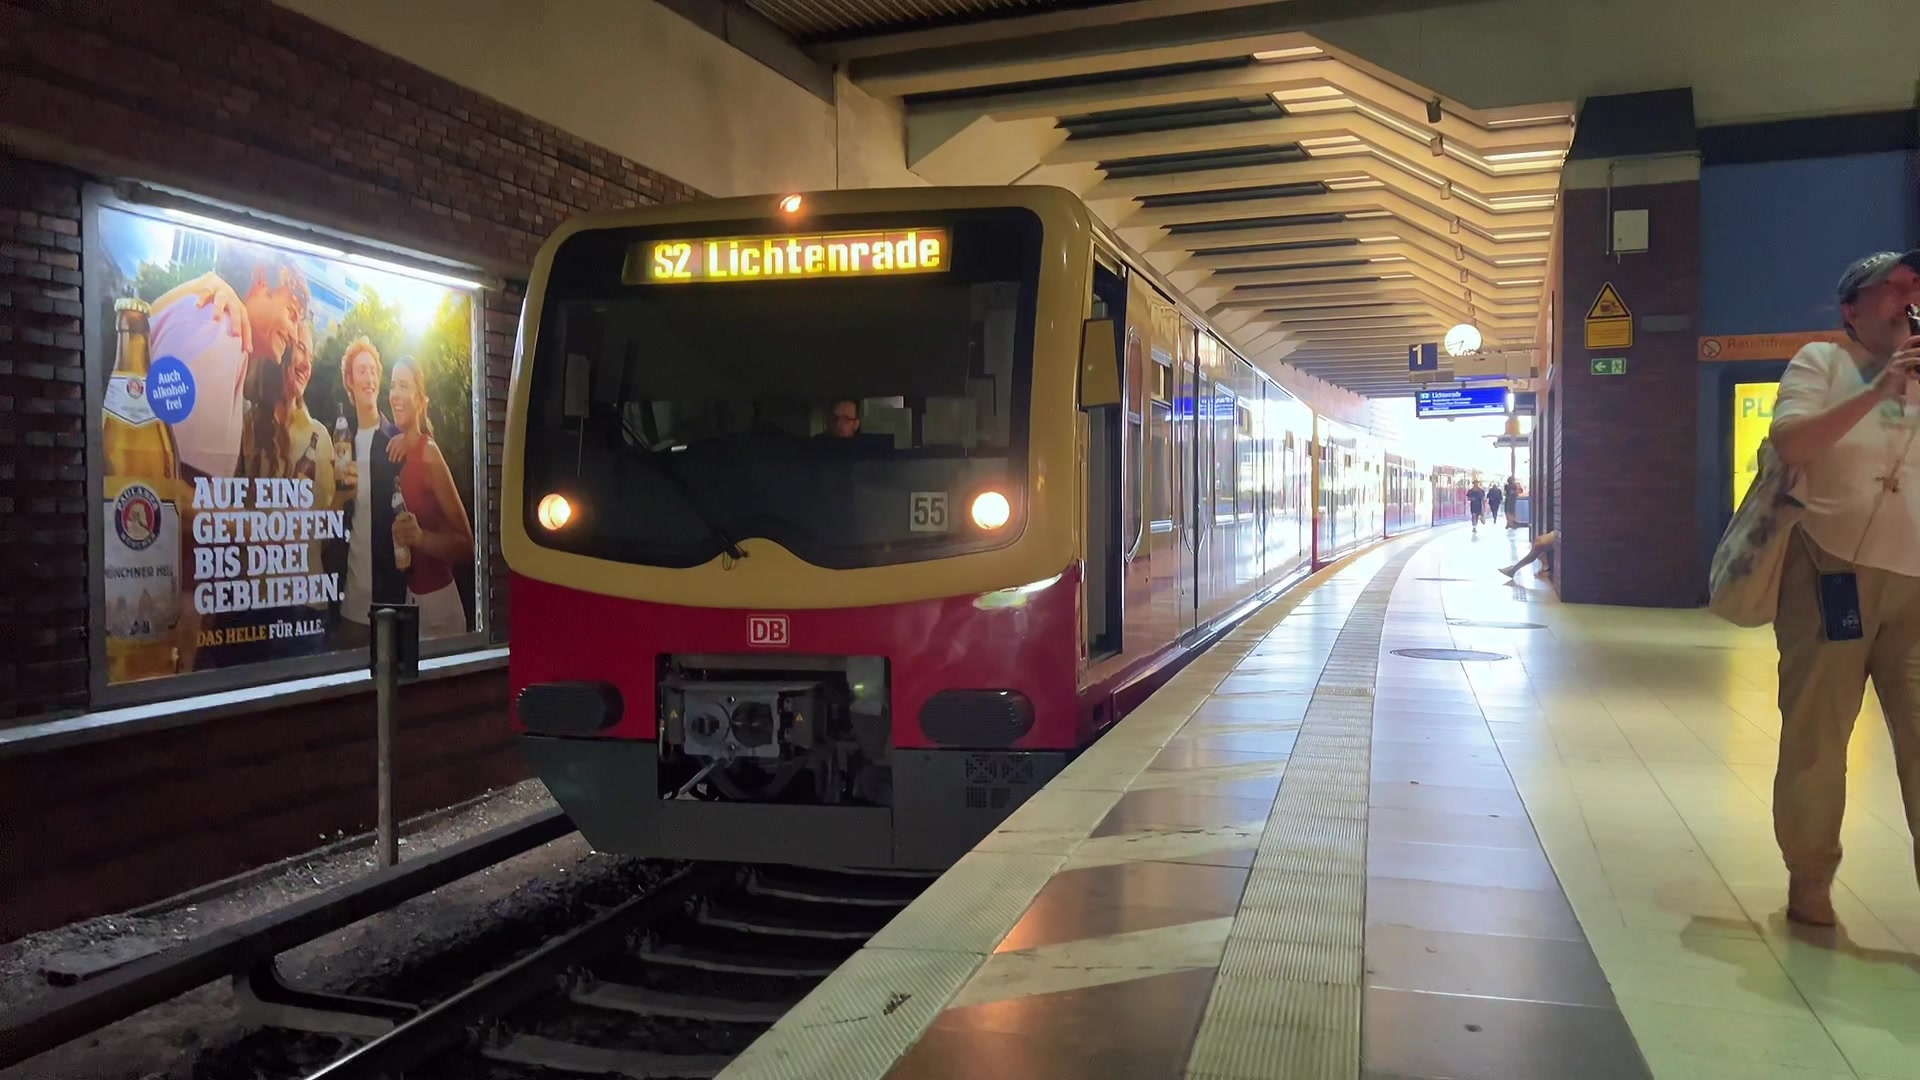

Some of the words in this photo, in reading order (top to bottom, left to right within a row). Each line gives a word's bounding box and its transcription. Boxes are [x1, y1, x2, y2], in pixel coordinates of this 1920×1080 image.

[654, 241, 692, 280] S2
[707, 230, 942, 278] Lichtenrade
[1412, 344, 1423, 365] 1
[158, 369, 181, 384] Auch
[152, 382, 190, 400] alkohol-
[165, 396, 183, 411] frei
[1742, 397, 1775, 418] PL
[191, 477, 249, 509] AUF
[254, 477, 314, 509] EINS
[914, 497, 945, 526] 55
[192, 510, 350, 545] GETROFFEN,
[193, 545, 242, 580] BIS
[247, 543, 309, 577] DREI
[194, 572, 345, 615] GEBLIEBEN.
[196, 629, 223, 647] DAS
[225, 624, 267, 644] HELLE
[268, 619, 293, 639] FÜR
[295, 619, 325, 636] ALLE.
[752, 620, 785, 642] DB
